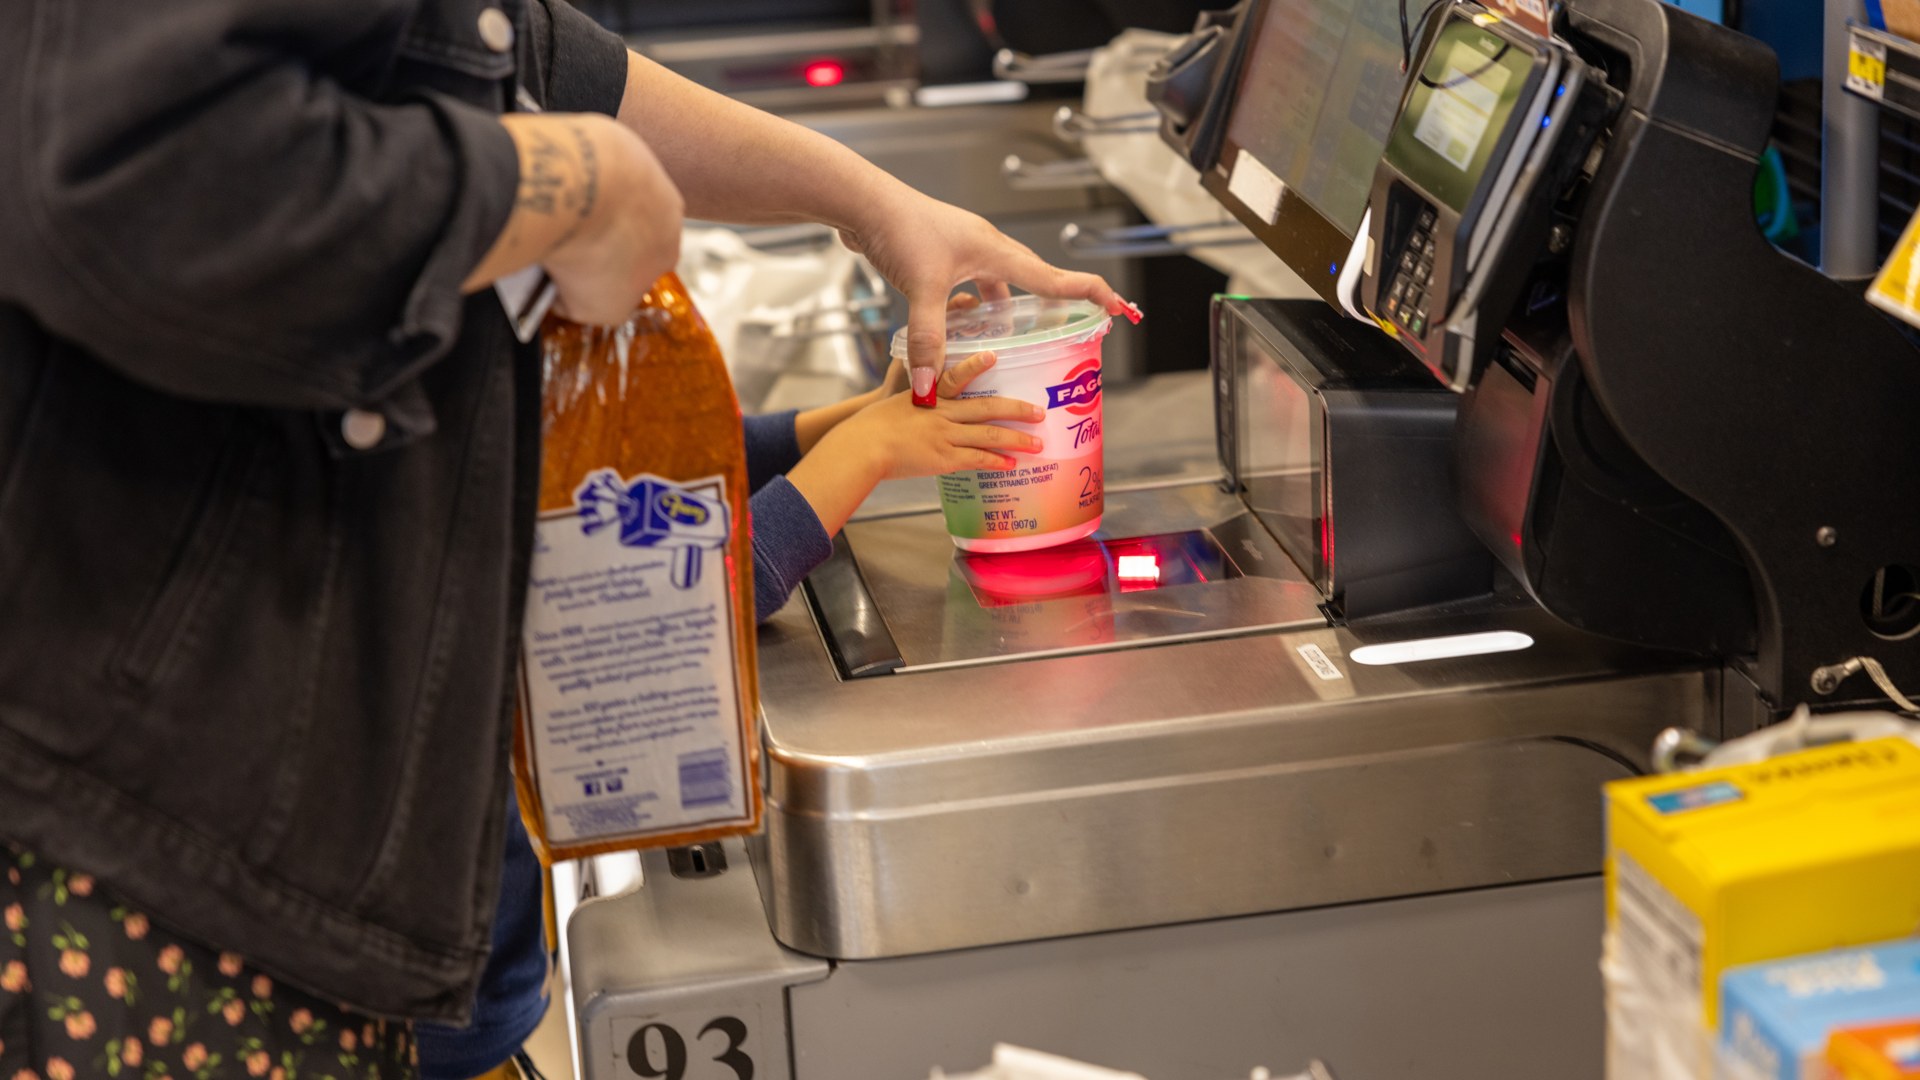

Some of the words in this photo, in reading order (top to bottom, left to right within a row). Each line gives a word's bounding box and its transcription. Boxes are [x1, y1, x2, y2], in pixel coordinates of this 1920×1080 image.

[977, 470, 1005, 480] REDUCED
[1006, 470, 1017, 478] FAT
[1032, 462, 1059, 475] MILKFAT)
[978, 481, 998, 490] GREEK
[999, 478, 1030, 488] STRAINED
[1030, 473, 1053, 484] YOGURT
[984, 511, 1000, 521] NET
[1001, 510, 1016, 520] WT.
[986, 522, 997, 532] 32
[998, 521, 1009, 531] OZ
[1011, 518, 1038, 531] (907g)
[627, 1016, 755, 1080] 93
